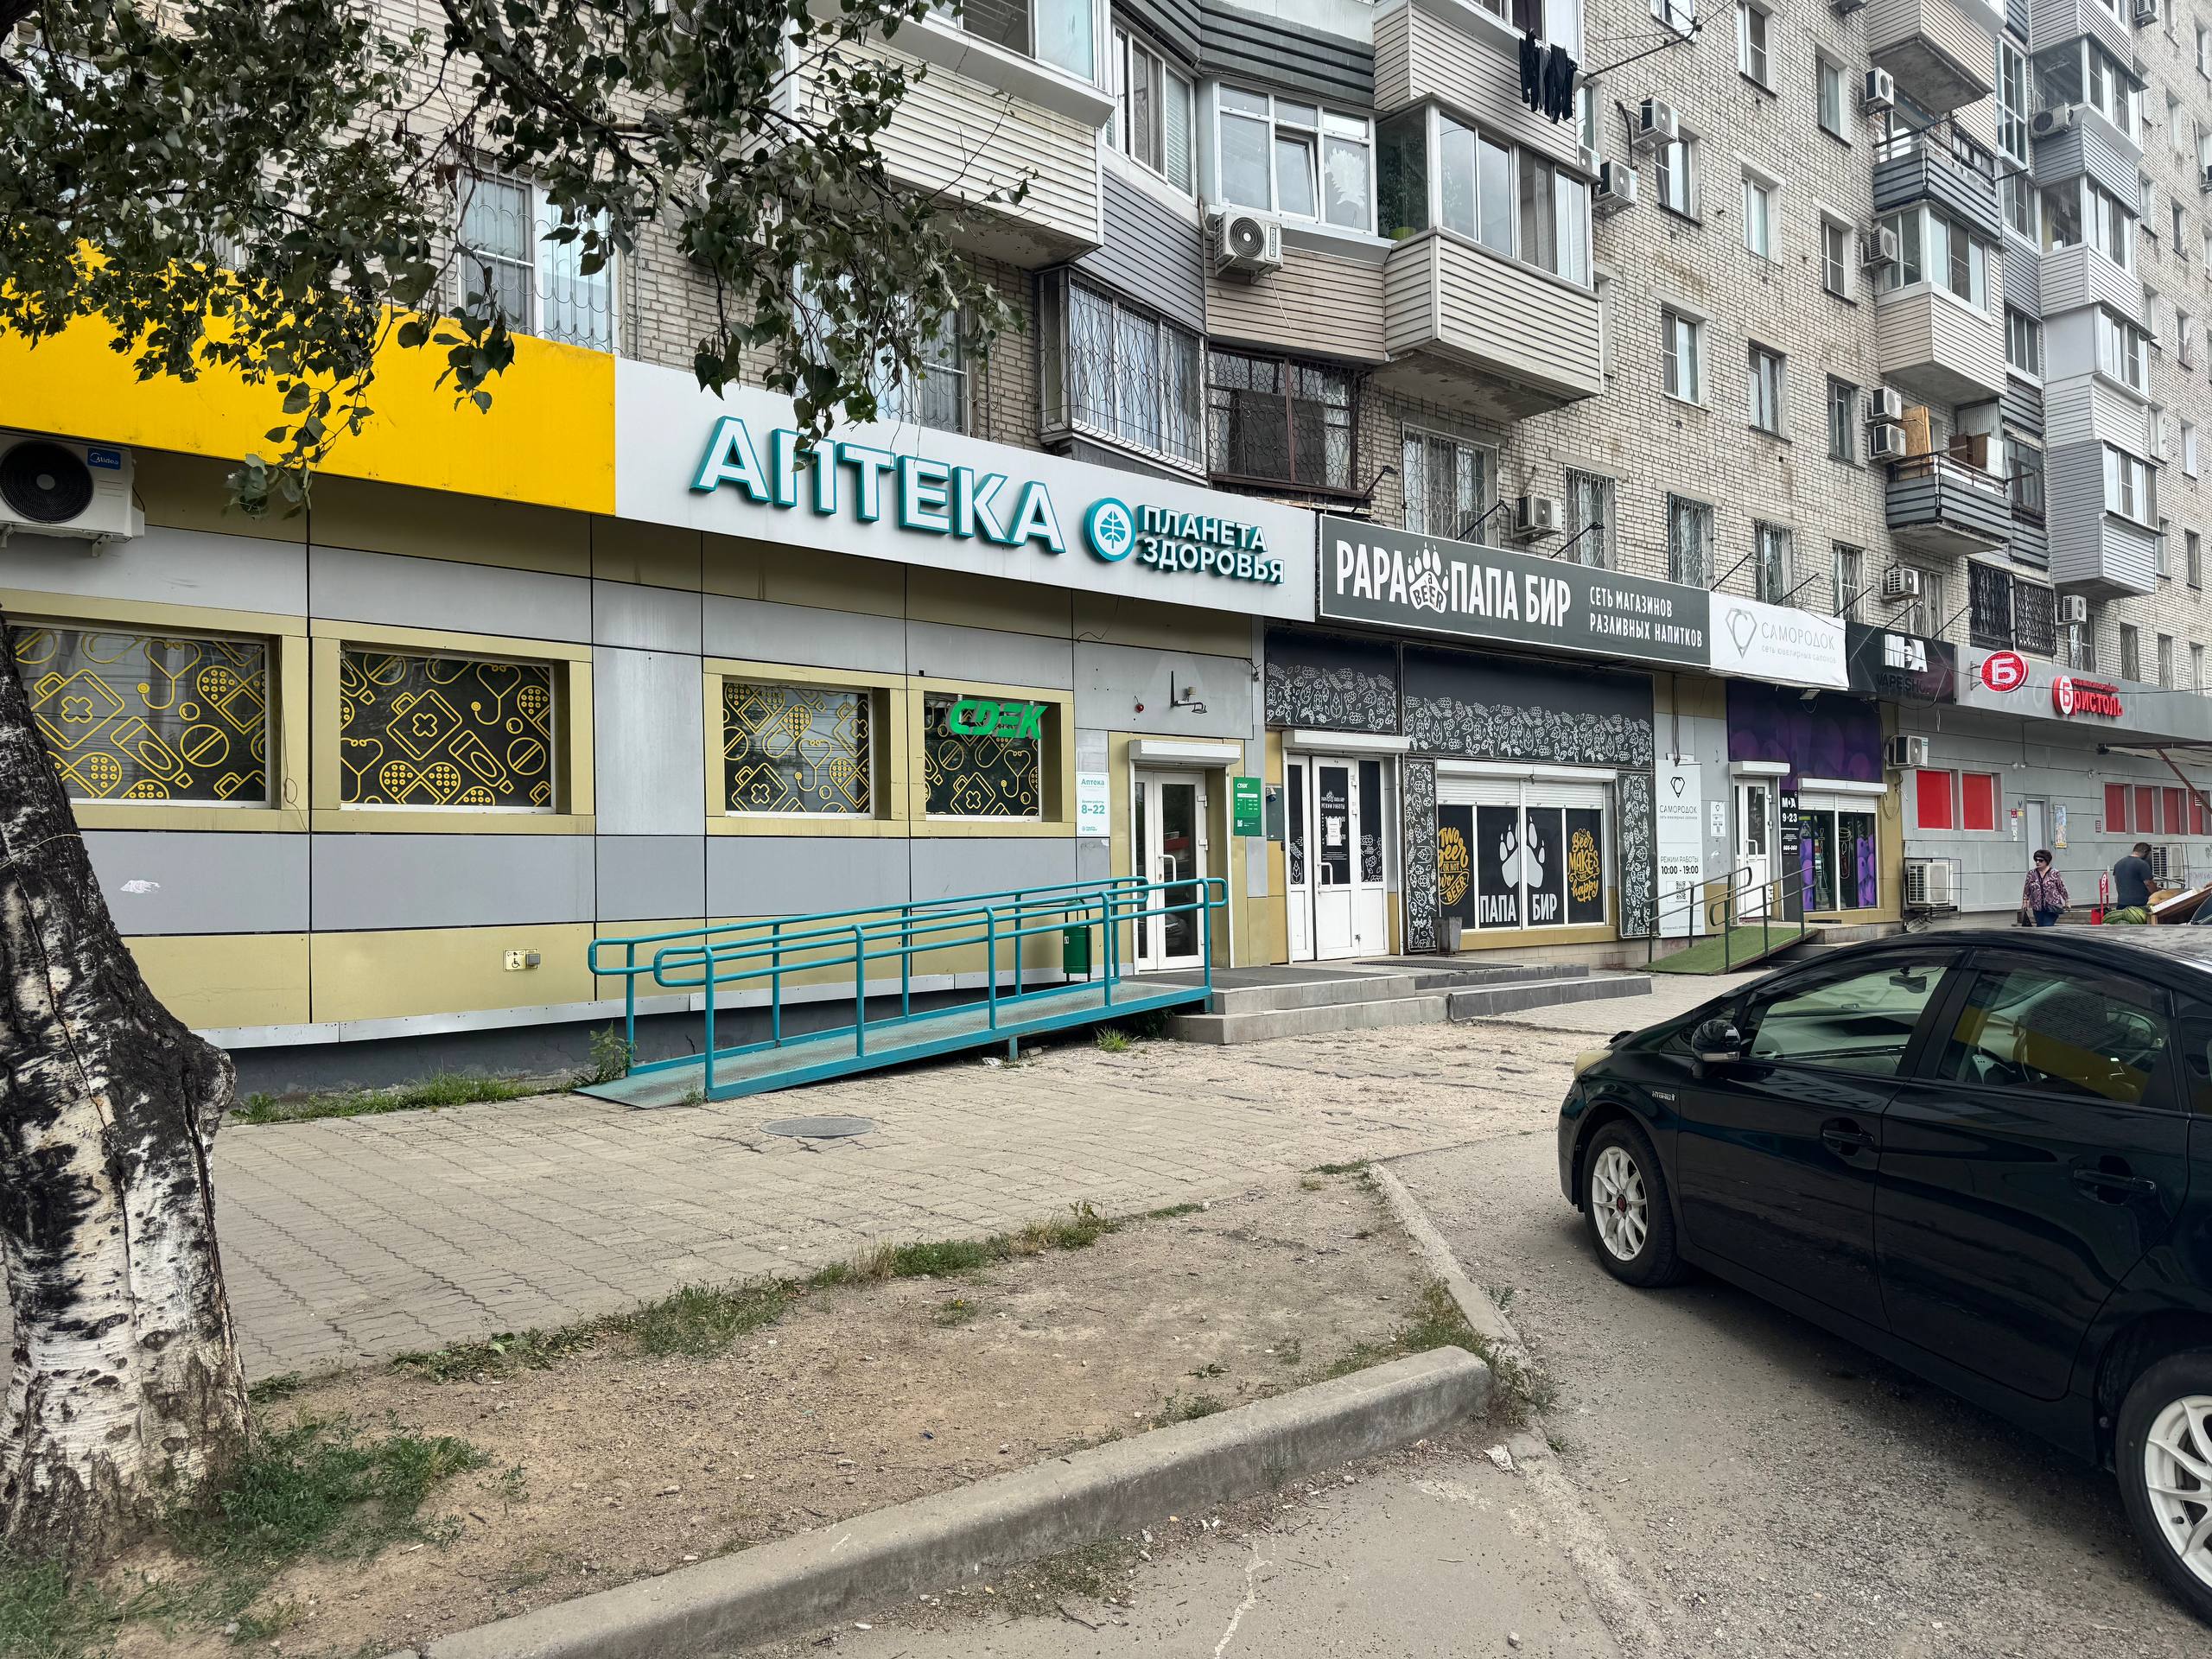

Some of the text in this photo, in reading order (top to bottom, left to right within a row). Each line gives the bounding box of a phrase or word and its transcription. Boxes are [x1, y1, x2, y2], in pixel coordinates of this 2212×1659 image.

[690, 415, 1067, 554] АПТЕКА
[1137, 504, 1268, 553] ПЛАНЕТА
[1136, 537, 1286, 584] ЗДОРОВЬЯ
[1413, 585, 1444, 611] BEER
[1451, 560, 1571, 627] ПАПА БИР
[1589, 586, 1673, 618] СЕТЬ МАГАЗИНОВ
[1590, 613, 1702, 648] РАЗЛИВНЫХ НАПИТКОВ
[1761, 622, 1834, 650] САМОРОДОК
[1991, 658, 2018, 685] Б
[1081, 804, 1105, 814] 8-22
[1659, 804, 1698, 814] САМОРОДОК
[1661, 866, 1678, 874] 10:00
[1683, 866, 1699, 874] 19:00
[1479, 893, 1557, 923] ПАПА БИР
